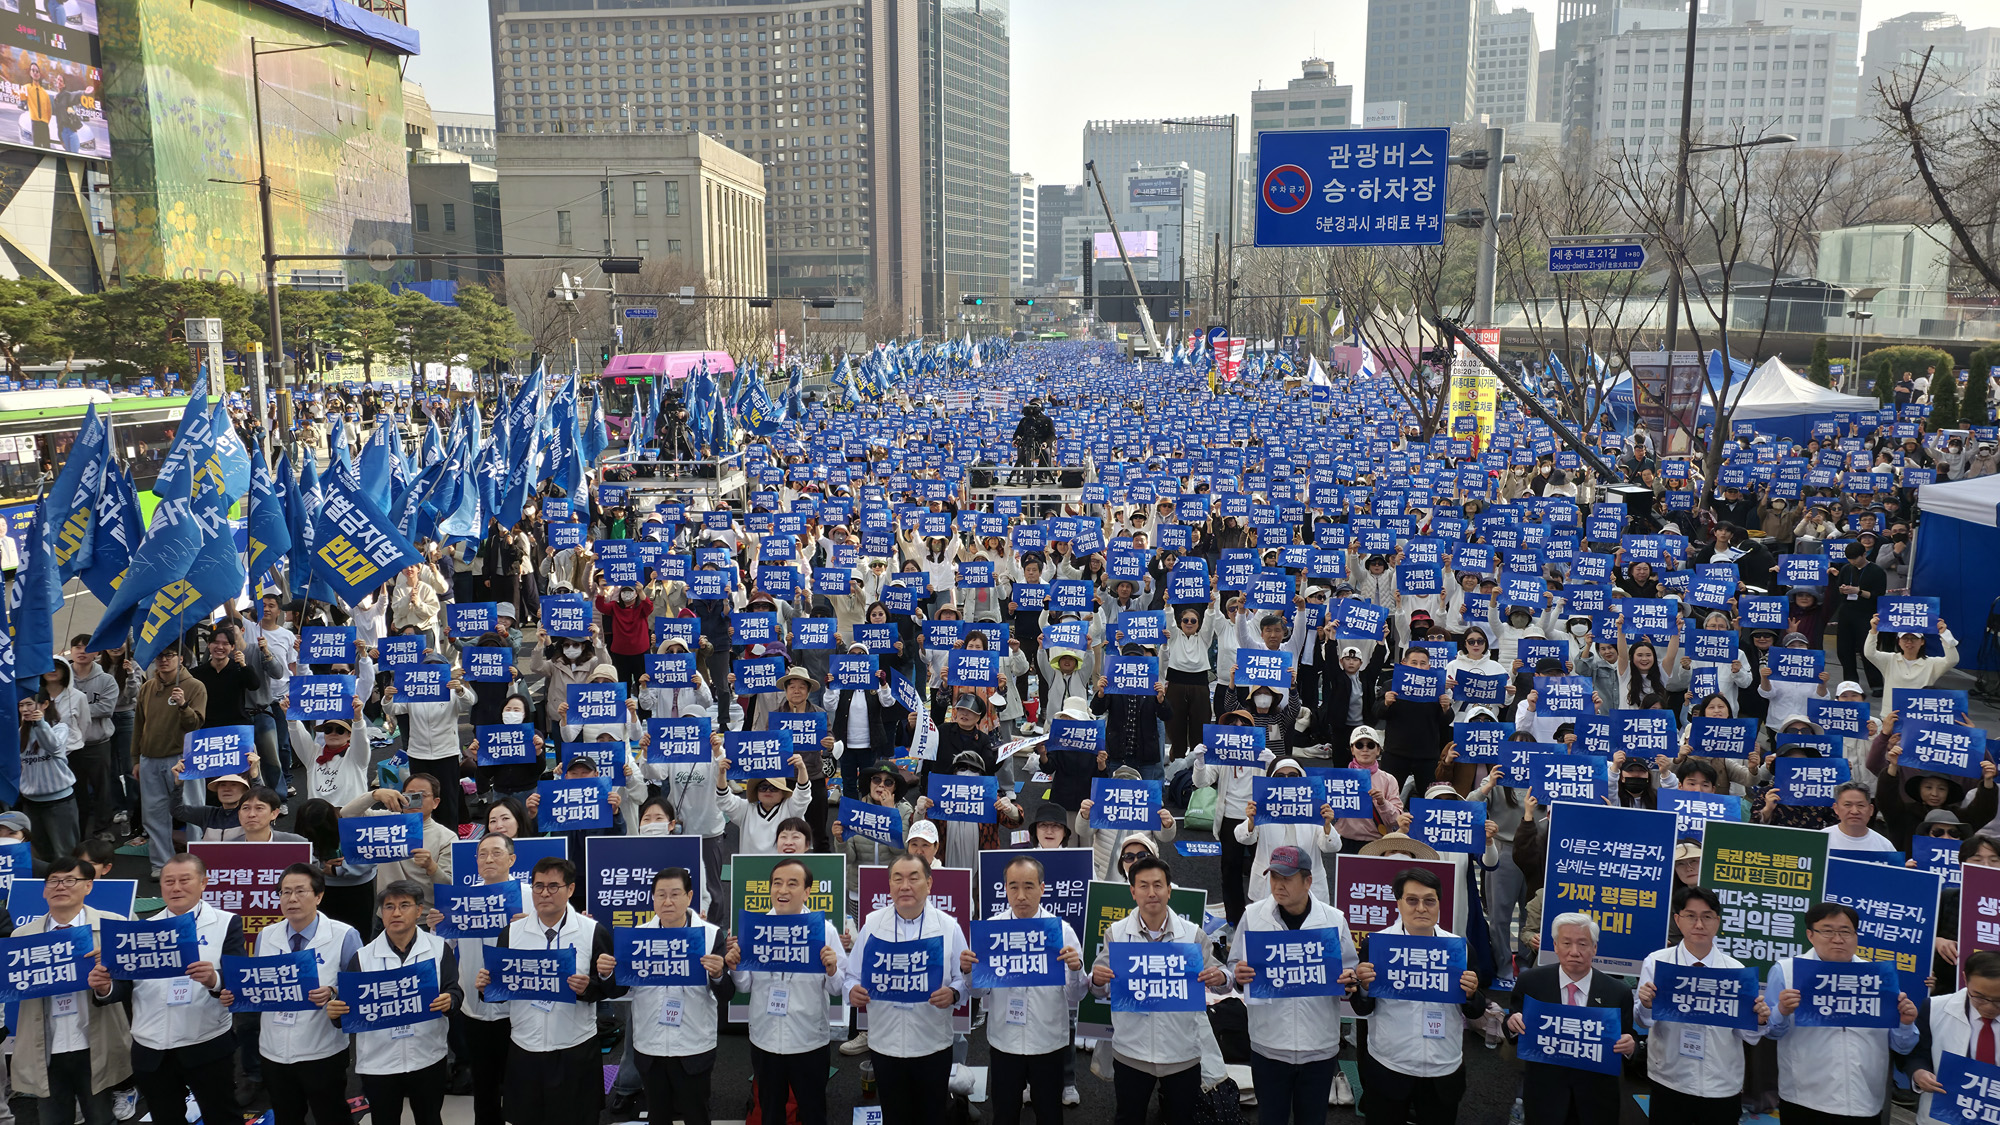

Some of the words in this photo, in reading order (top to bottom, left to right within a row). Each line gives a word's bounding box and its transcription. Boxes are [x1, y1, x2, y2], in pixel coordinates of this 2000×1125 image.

[1328, 143, 1434, 169] 관광버스
[1322, 176, 1436, 203] 승·하차장
[1316, 216, 1370, 233] 5분경과시
[1375, 215, 1410, 231] 과태료
[1415, 214, 1439, 230] 부과
[324, 483, 404, 567] 차별금지법
[317, 534, 379, 586] 반대
[1890, 603, 1928, 615] 거룩한
[1889, 615, 1928, 627] 방파제
[301, 683, 343, 697] 거룩한
[300, 698, 342, 713] 방파제
[194, 735, 240, 752] 거룩한
[1918, 730, 1971, 751] 거룩한
[193, 751, 240, 770] 방파제
[1916, 746, 1968, 768] 방파제
[1545, 764, 1594, 781] 거룩한
[1791, 767, 1838, 782] 거룩한
[553, 787, 599, 804] 거룩한
[942, 784, 985, 800] 거룩한
[1105, 789, 1149, 805] 거룩한
[1544, 782, 1593, 799] 방파제
[1790, 784, 1836, 798] 방파제
[552, 804, 599, 822] 방파제
[941, 801, 984, 815] 방파제
[1104, 806, 1148, 822] 방파제
[1560, 838, 1600, 856] 이름은
[1602, 841, 1665, 862] 차별금지,
[1716, 848, 1743, 864] 특권
[1745, 852, 1771, 866] 없는
[1772, 854, 1812, 870] 평등이
[206, 869, 254, 885] 생각할
[600, 868, 629, 885] 입을
[1556, 859, 1596, 876] 실체는
[1598, 862, 1662, 881] 반대금지!
[1716, 866, 1745, 882] 진짜
[1749, 869, 1810, 888] 평등이다
[746, 881, 770, 893] 특권
[1056, 880, 1084, 897] 법은
[1557, 882, 1596, 902] 가짜
[1601, 886, 1657, 908] 평등법
[202, 891, 244, 910] 말할
[451, 894, 506, 912] 거룩한
[1761, 894, 1809, 913] 국민의
[1101, 906, 1126, 918] 특권
[1349, 904, 1389, 926] 말할
[1856, 898, 1926, 924] 차별금지,
[452, 914, 507, 930] 방파제
[1721, 908, 1795, 938] 권익을
[116, 930, 179, 950] 거룩한
[754, 925, 810, 944] 거룩한
[990, 930, 1046, 952] 거룩한
[8, 941, 74, 966] 거룩한
[632, 939, 689, 958] 거룩한
[754, 945, 809, 963] 방파제
[1266, 942, 1324, 963] 거룩한
[116, 951, 182, 971] 방파제
[502, 959, 559, 975] 거룩한
[632, 960, 689, 977] 방파제
[873, 951, 929, 972] 거룩한
[990, 954, 1048, 976] 방파제
[1129, 954, 1186, 976] 거룩한
[1389, 948, 1450, 970] 거룩한
[8, 963, 76, 990] 방파제
[240, 964, 299, 984] 거룩한
[502, 975, 559, 992] 방파제
[872, 973, 928, 992] 방파제
[1266, 965, 1326, 987] 방파제
[1388, 970, 1448, 992] 방파제
[242, 985, 303, 1003] 방파제
[358, 975, 420, 999] 거룩한
[1129, 979, 1188, 1000] 방파제
[1675, 976, 1741, 997] 거룩한
[1815, 974, 1882, 995] 거룩한
[359, 995, 422, 1021] 방파제
[1672, 994, 1738, 1017] 방파제
[1813, 995, 1880, 1016] 방파제
[1539, 1015, 1604, 1041] 거룩한
[1538, 1035, 1602, 1062] 방파제
